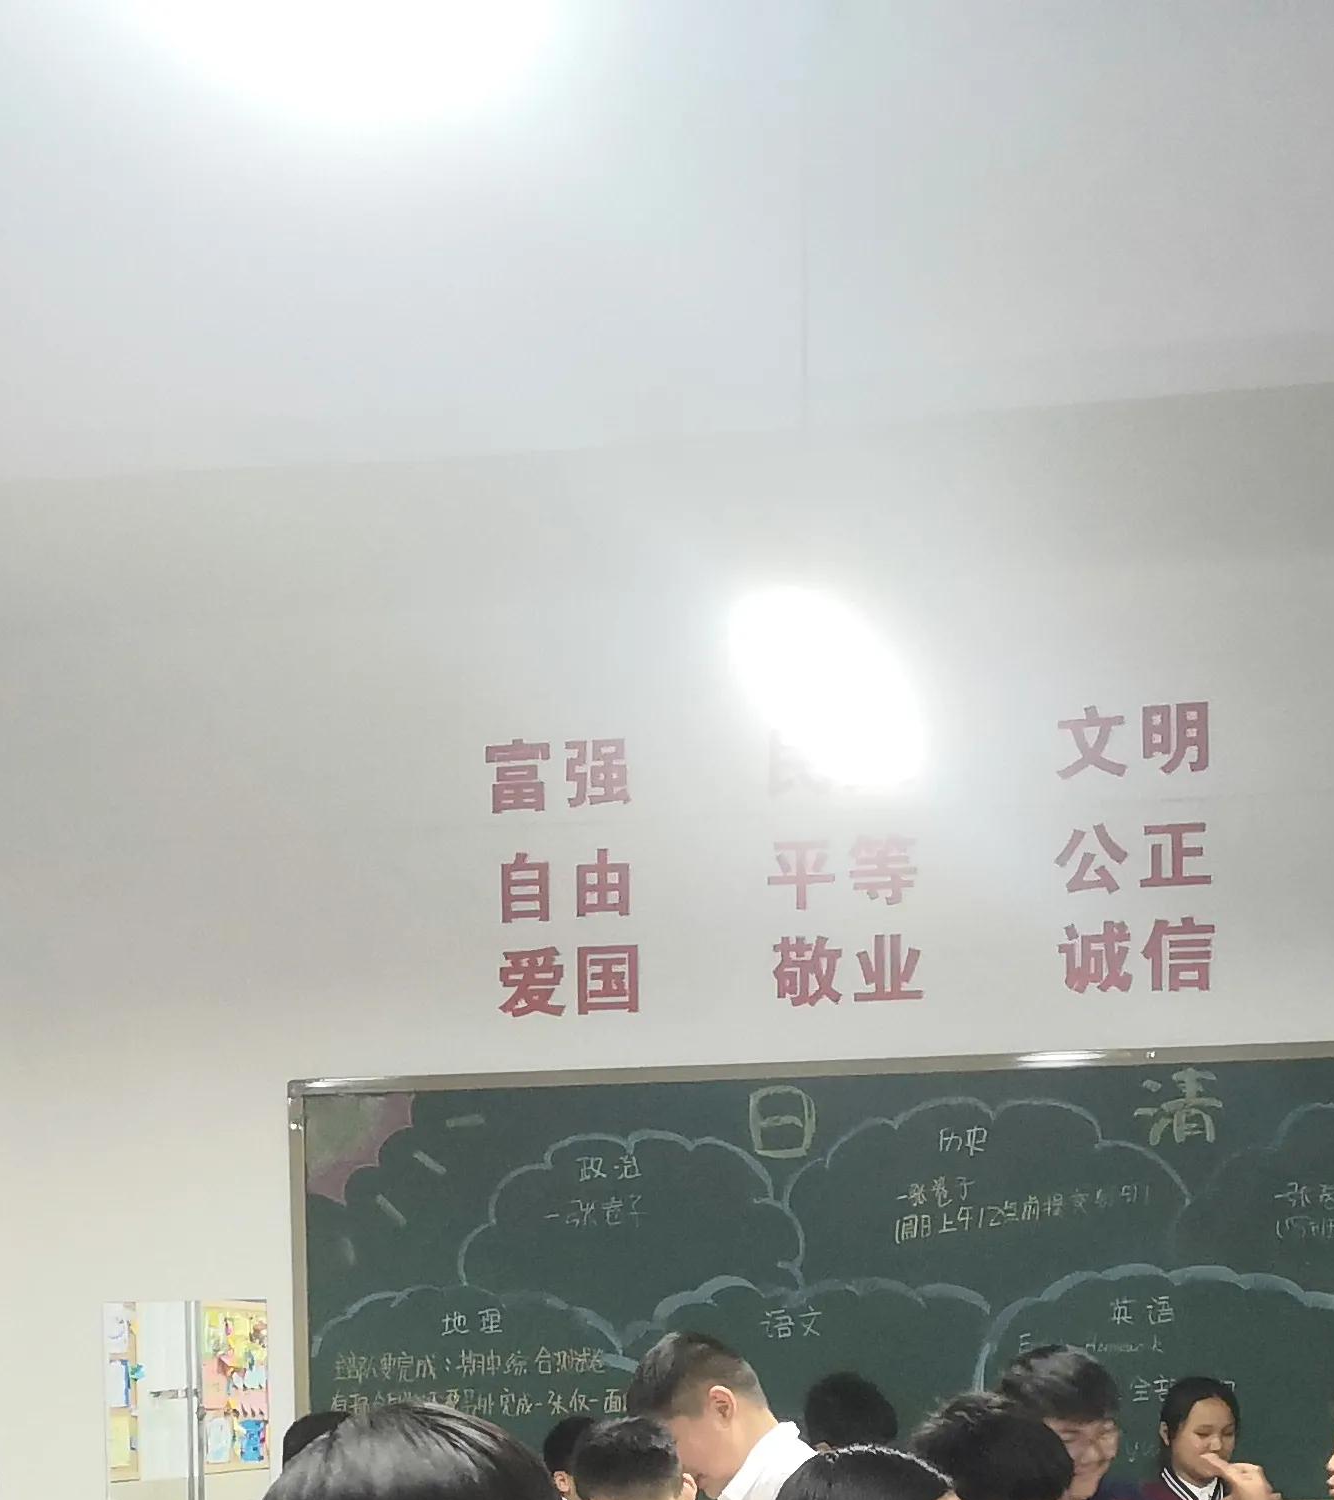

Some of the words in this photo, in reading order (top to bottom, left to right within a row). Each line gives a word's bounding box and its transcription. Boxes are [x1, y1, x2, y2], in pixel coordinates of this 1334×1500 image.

[484, 736, 633, 814] 富强
[1055, 701, 1210, 777] 文明
[498, 849, 633, 923] 自由
[767, 834, 920, 911] 平等
[1055, 822, 1213, 894] 公正
[497, 943, 641, 1017] 爱国
[771, 933, 925, 1008] 敬业
[1058, 917, 1216, 995] 诚信
[938, 1126, 988, 1156] 历史
[575, 1155, 642, 1182] 政治
[441, 1307, 503, 1337] 地理
[759, 1305, 823, 1338] 语文
[1110, 1295, 1174, 1326] 英语
